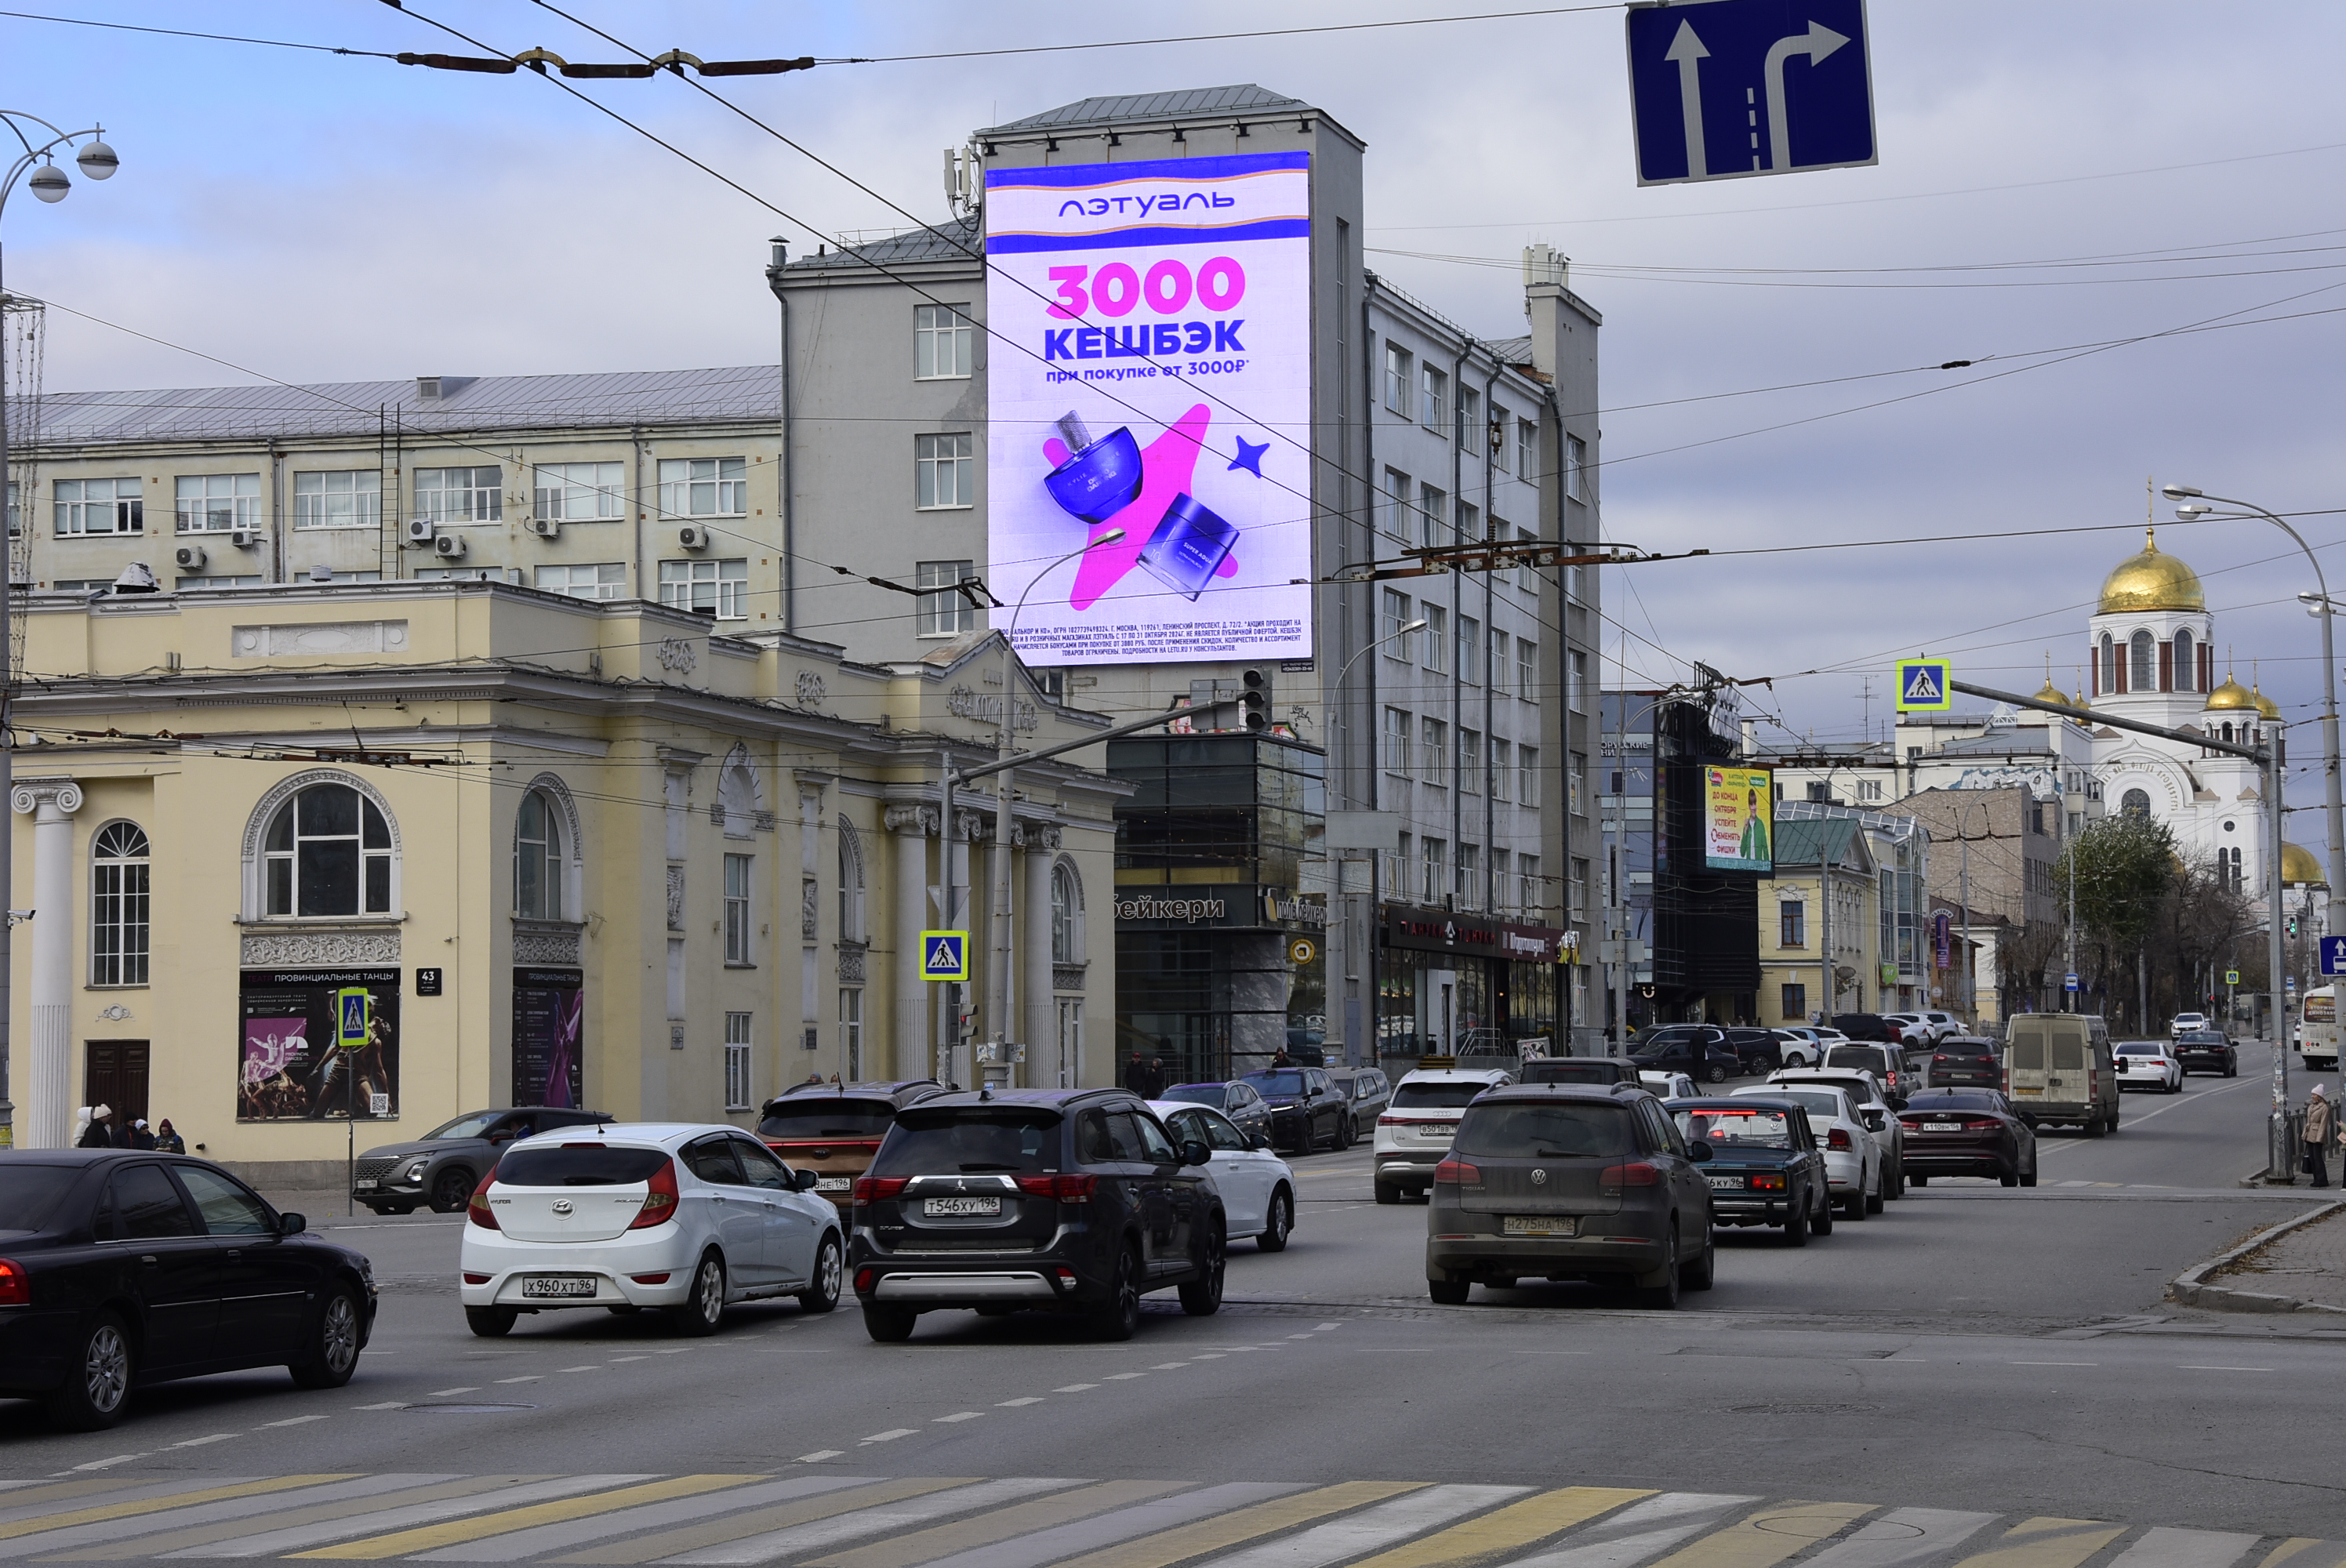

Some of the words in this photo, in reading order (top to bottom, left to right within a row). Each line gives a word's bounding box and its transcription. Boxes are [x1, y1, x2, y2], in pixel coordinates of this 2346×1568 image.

[1059, 191, 1235, 218] ЛЭТУАЛЬ
[1045, 256, 1246, 320] 3000
[1044, 319, 1246, 361] КЕШБЭК
[1046, 371, 1078, 384] при
[1084, 365, 1157, 381] покупке
[1162, 365, 1182, 376] от
[1183, 542, 1200, 555] SUPER
[1198, 553, 1212, 564] AQUA
[1712, 791, 1720, 800] ДО
[1721, 793, 1738, 802] КОНЦА
[1714, 804, 1737, 815] ОКТЯБРЯ
[1714, 818, 1737, 828] УСПЕЙТЕ
[1716, 845, 1736, 855] ФИШКИ
[1400, 920, 1445, 938] ТАНУКИ
[1458, 927, 1494, 945] ТАНУКИ
[274, 973, 361, 982] ПРОВИНЦИАЛЬНЫЕ
[363, 972, 394, 981] ТАНЦЫ
[421, 971, 434, 981] 43
[833, 1178, 848, 1187] 196
[928, 1200, 975, 1212] Т546ХУ
[979, 1197, 997, 1208] 196
[1507, 1218, 1552, 1230] Н275НА
[1554, 1218, 1571, 1227] 196
[579, 1279, 591, 1290] 96
